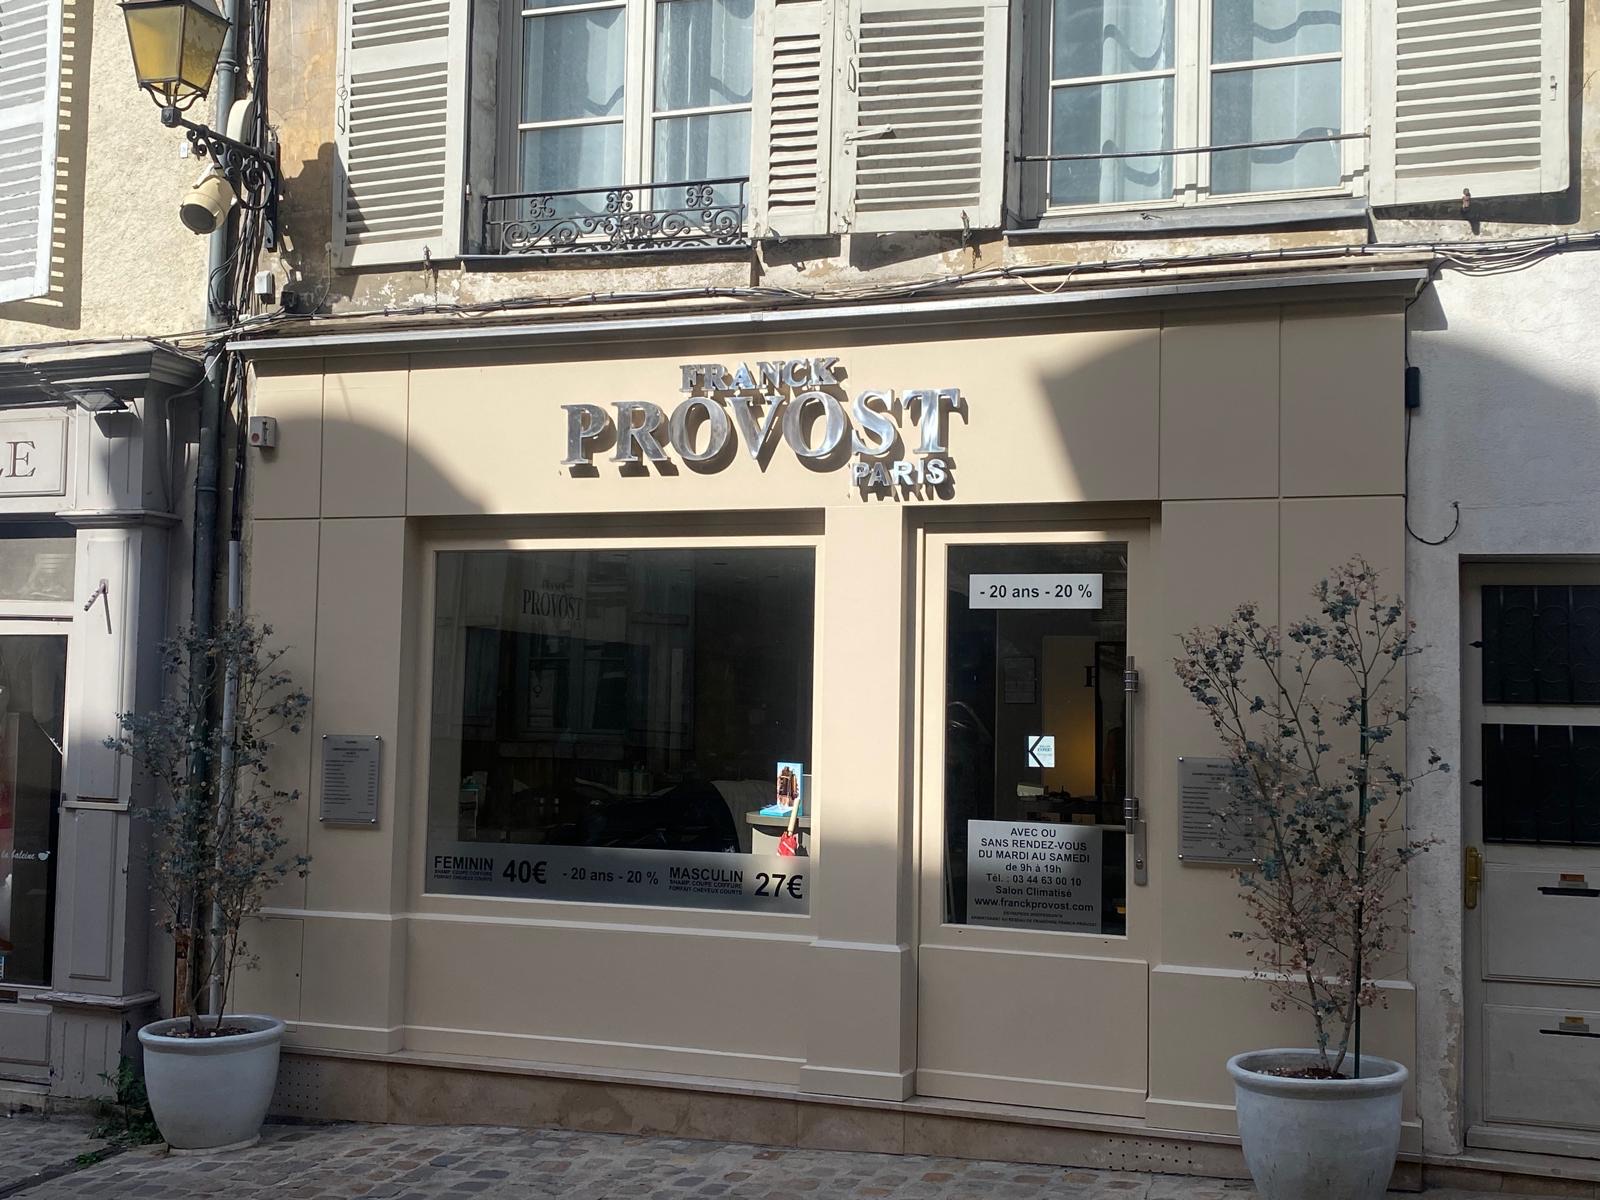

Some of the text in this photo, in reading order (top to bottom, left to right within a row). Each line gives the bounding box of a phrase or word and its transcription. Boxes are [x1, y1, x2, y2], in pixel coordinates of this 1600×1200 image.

[679, 357, 840, 392] FRANCK
[560, 387, 961, 465] PROVOST
[851, 458, 947, 487] PARIS
[989, 585, 1007, 598] 20
[1012, 587, 1040, 598] ans
[1054, 584, 1073, 598] 20
[1078, 584, 1093, 598] %
[522, 589, 584, 621] PROVOST
[1010, 828, 1057, 838] AVEC OU
[981, 838, 1087, 851] SANS RENDEZ-VOUS
[434, 856, 494, 871] FEMININ
[978, 849, 1090, 863] DU MARDI AU SAMEDI
[502, 860, 548, 885] 40€
[669, 867, 743, 882] MASCULIN
[1005, 863, 1018, 872] de
[1020, 863, 1032, 872] 9h
[1045, 864, 1062, 873] 19h
[571, 867, 587, 881] 20
[590, 871, 614, 882] ans
[626, 870, 642, 883] 20
[646, 871, 659, 885] %
[1012, 874, 1024, 884] 03
[1026, 875, 1038, 884] 44
[1041, 876, 1053, 885] 63
[1055, 877, 1067, 886] 00
[1070, 877, 1082, 887] 10
[754, 872, 804, 899] 27€
[995, 885, 1072, 897] Salon Climatisé
[974, 897, 1094, 912] www.franckprovost.com
